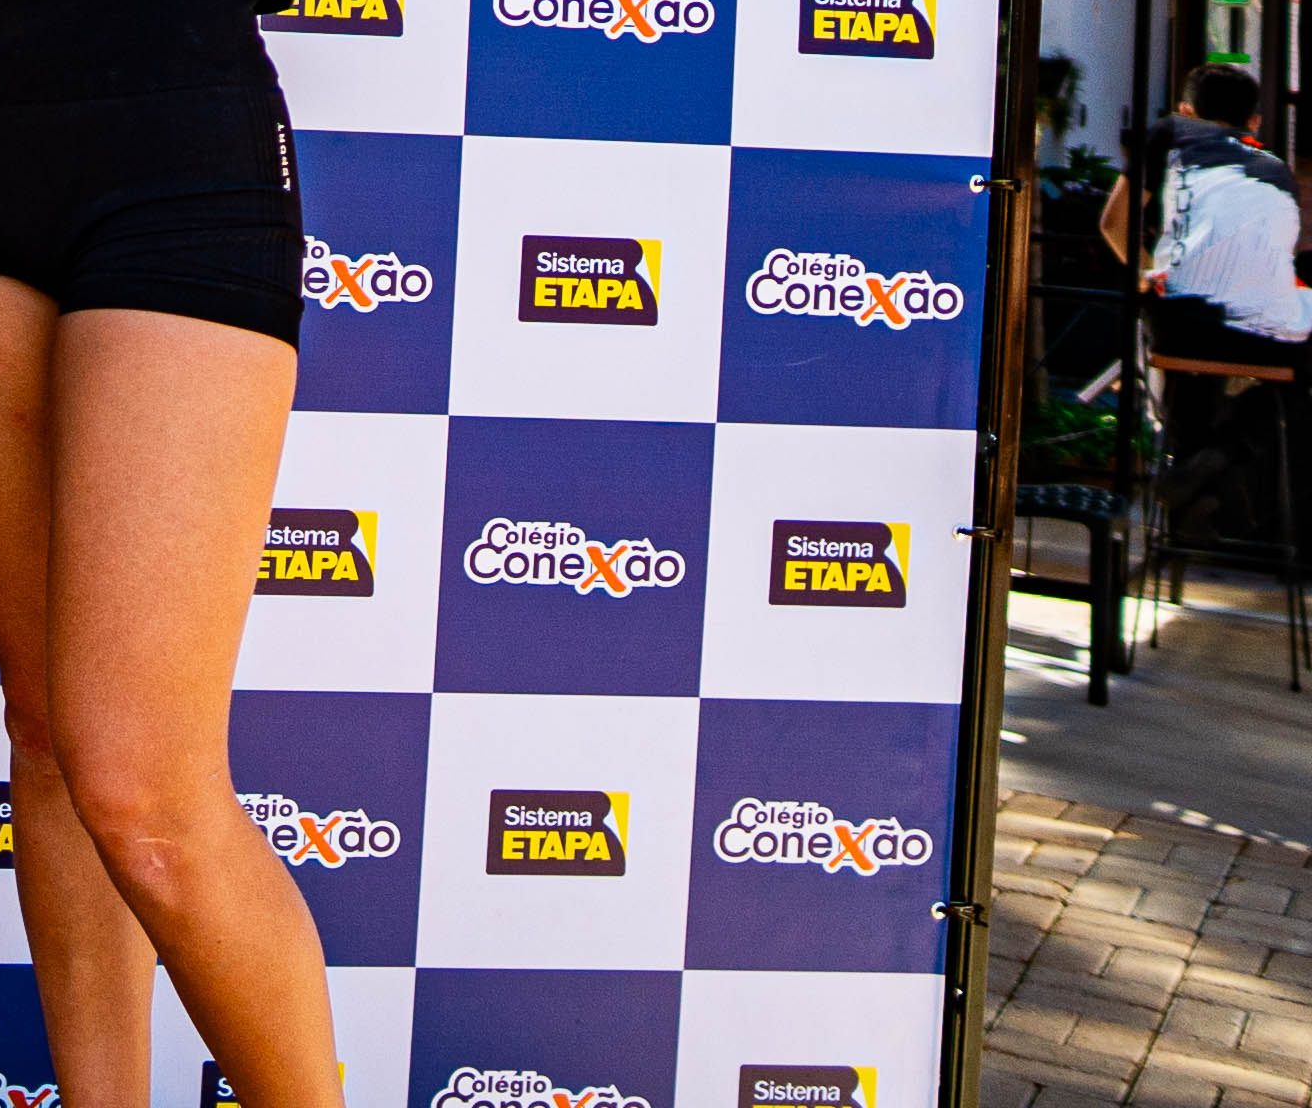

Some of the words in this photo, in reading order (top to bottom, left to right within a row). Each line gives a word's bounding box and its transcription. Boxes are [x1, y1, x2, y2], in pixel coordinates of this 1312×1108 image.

[810, 9, 920, 44] ETAPA
[536, 252, 625, 276] Sistema
[769, 253, 860, 281] Colégio
[532, 276, 644, 311] ETAPA
[265, 525, 340, 546] istema
[487, 521, 581, 549] Colégio
[787, 536, 873, 560] Sistema
[782, 560, 892, 594] ETAPA
[505, 806, 593, 829] Sistema
[736, 802, 829, 829] Colégio
[500, 829, 612, 863] ETAPA
[453, 1072, 547, 1098] Colégio
[753, 1080, 841, 1102] Sistema
